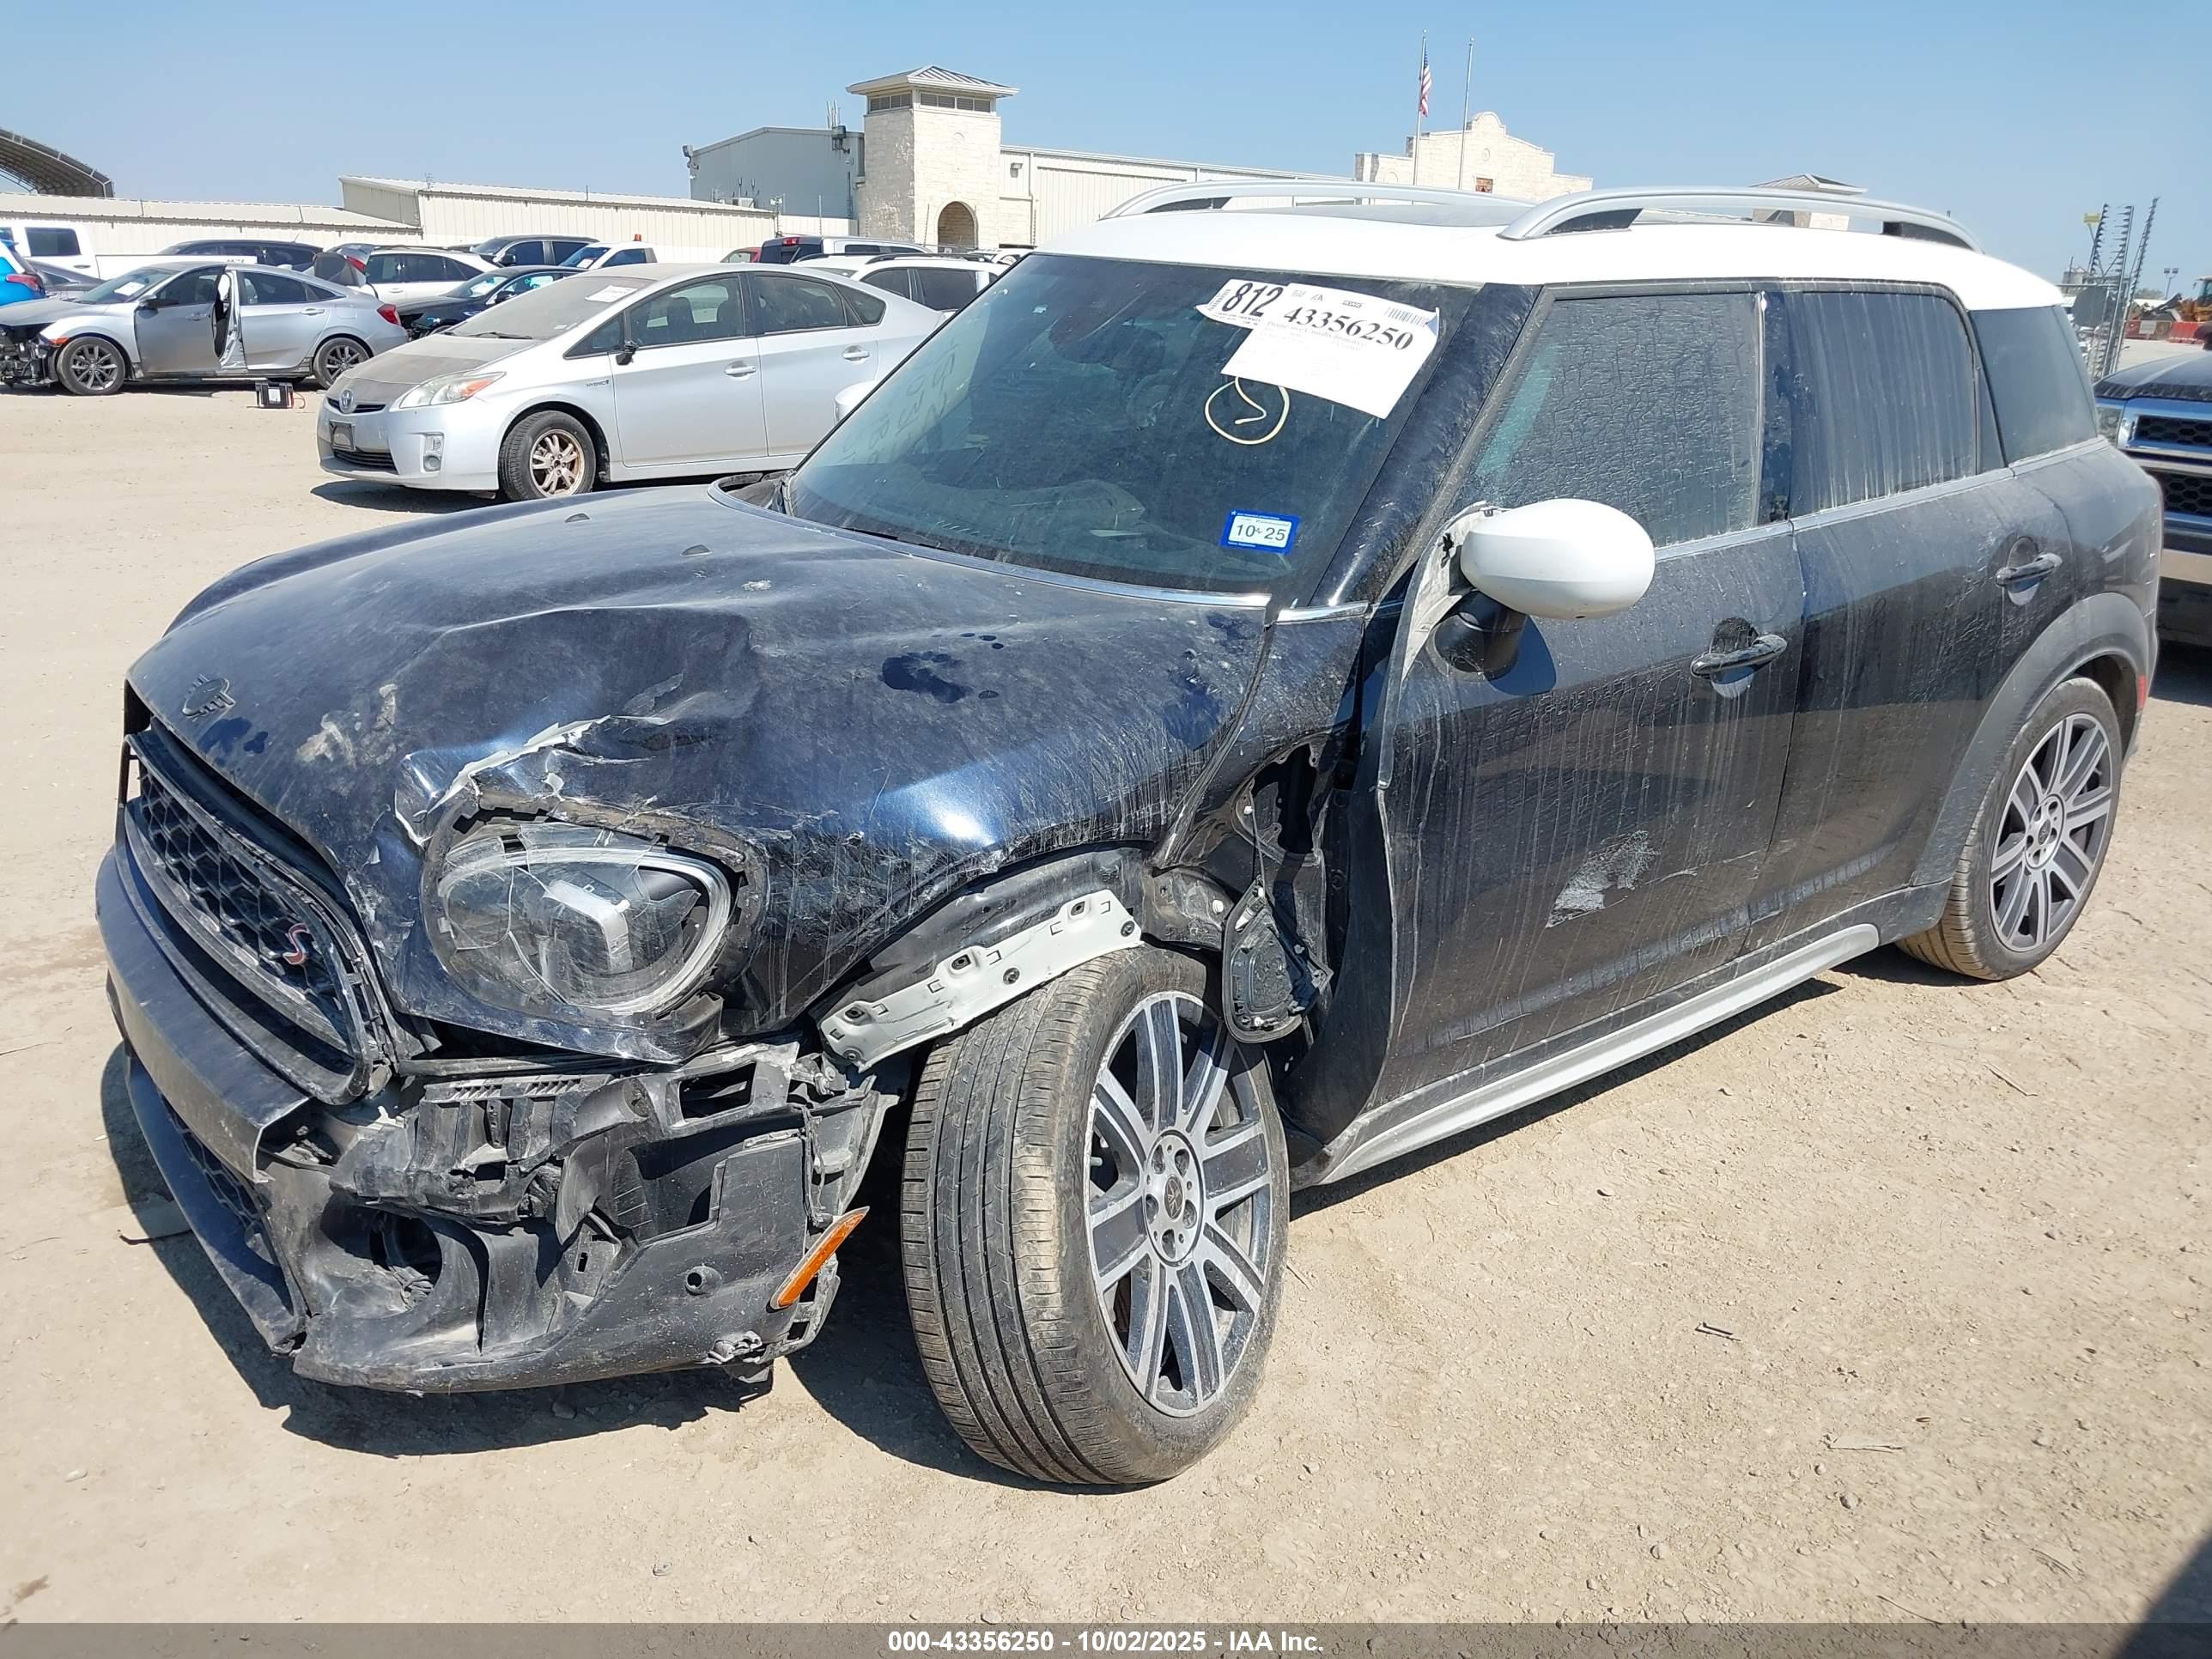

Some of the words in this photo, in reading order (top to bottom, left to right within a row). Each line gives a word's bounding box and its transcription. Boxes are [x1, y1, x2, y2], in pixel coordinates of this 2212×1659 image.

[1221, 282, 1285, 318] 812
[1283, 306, 1414, 350] 43356250
[1236, 524, 1256, 538] 10
[1263, 526, 1287, 542] 25
